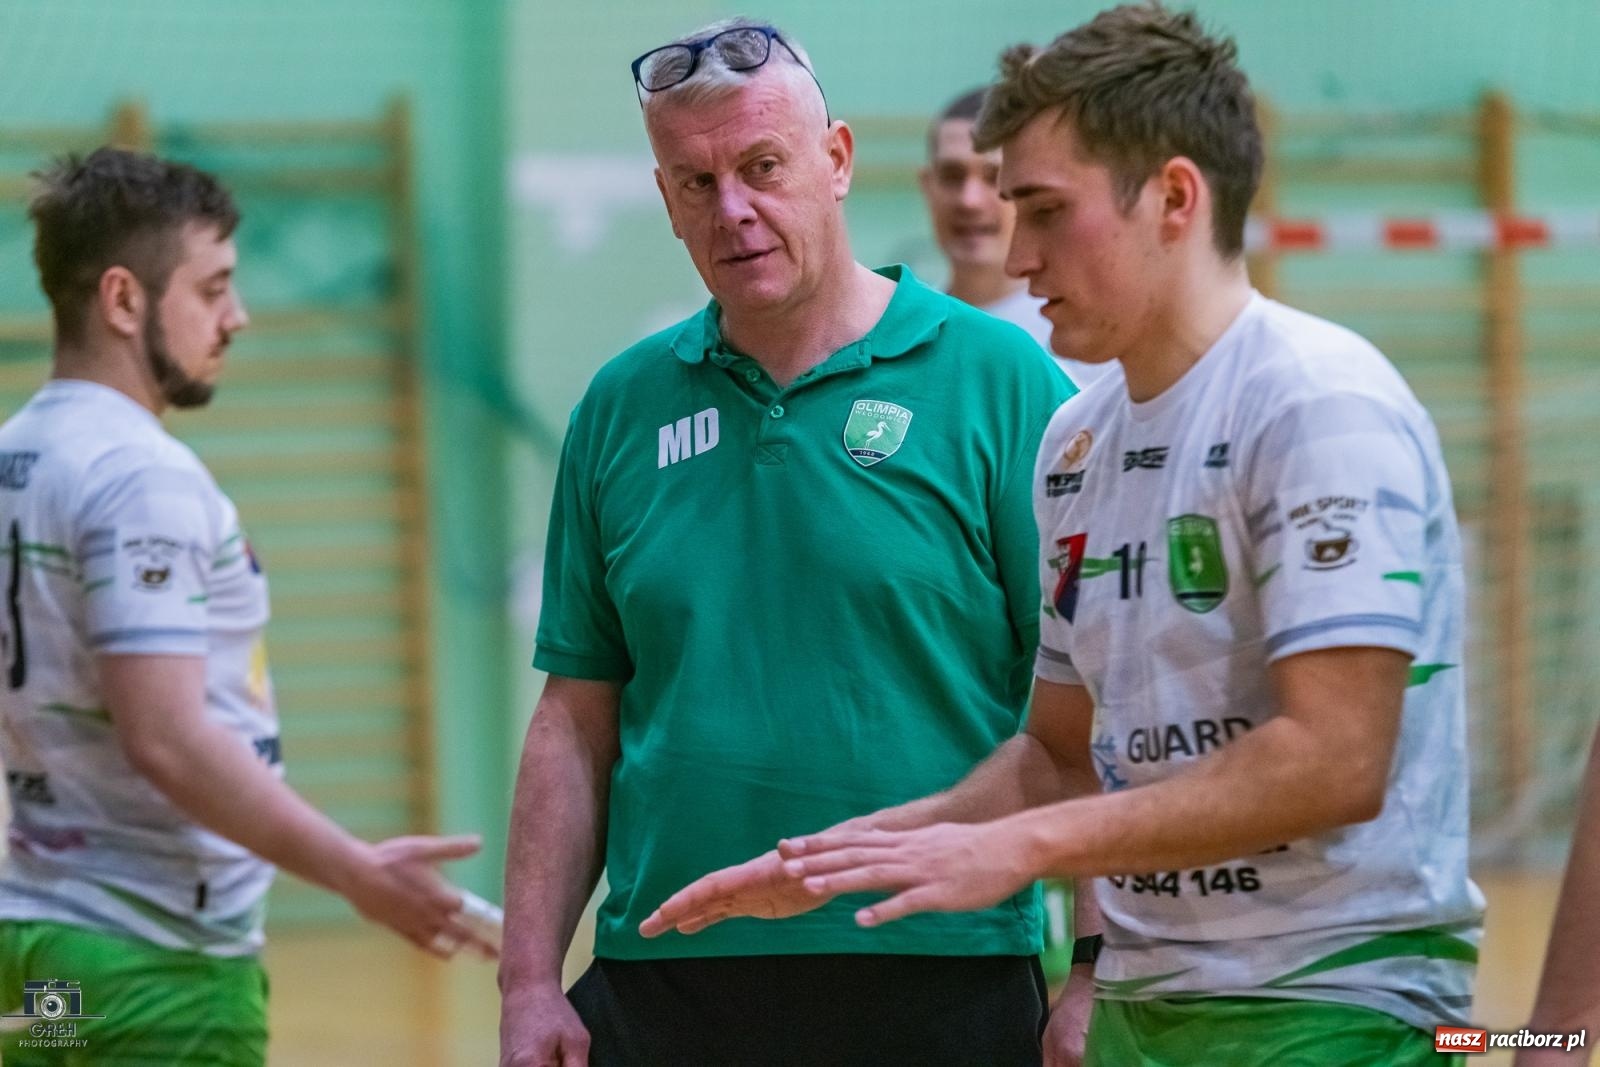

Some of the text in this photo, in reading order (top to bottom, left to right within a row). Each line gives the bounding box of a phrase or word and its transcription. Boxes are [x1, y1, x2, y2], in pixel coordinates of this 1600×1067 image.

[856, 402, 909, 420] OLIMPIA
[658, 407, 719, 469] MD
[1190, 867, 1261, 897] 146
